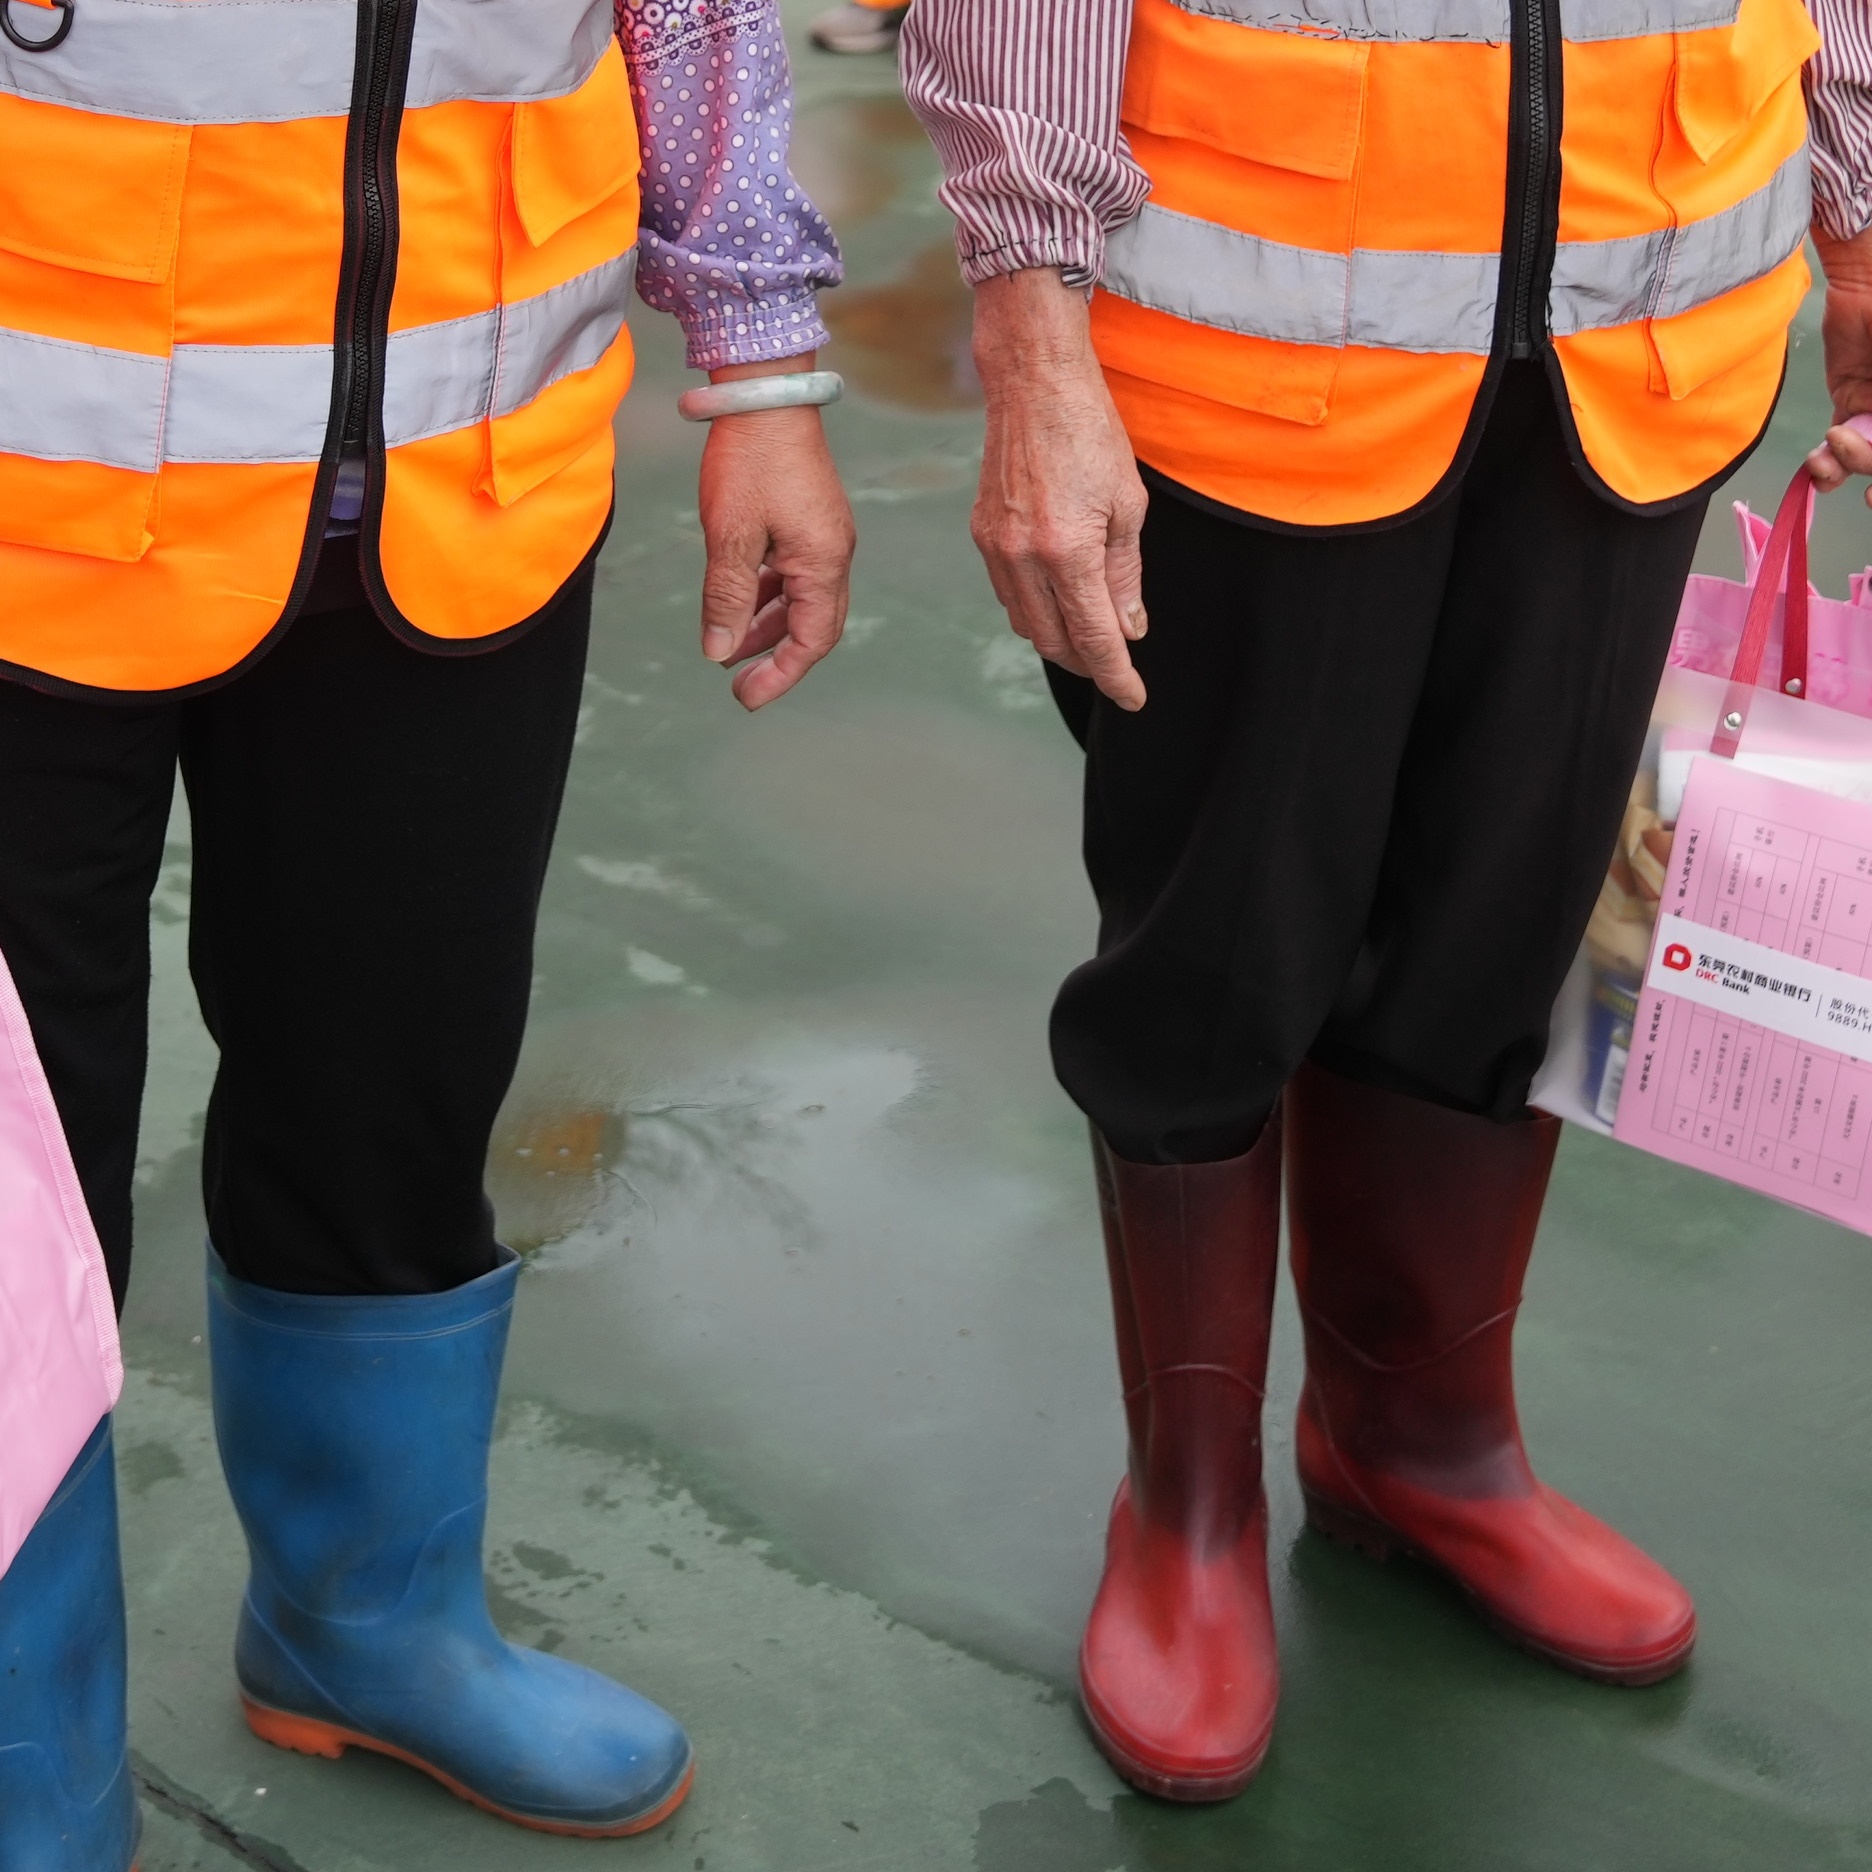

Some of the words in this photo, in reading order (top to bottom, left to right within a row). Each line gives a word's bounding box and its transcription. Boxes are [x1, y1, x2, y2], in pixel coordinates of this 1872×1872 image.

[1695, 969, 1720, 984] DRC
[1721, 977, 1752, 995] Bank
[1697, 953, 1813, 1004] 东莞农村商业银行
